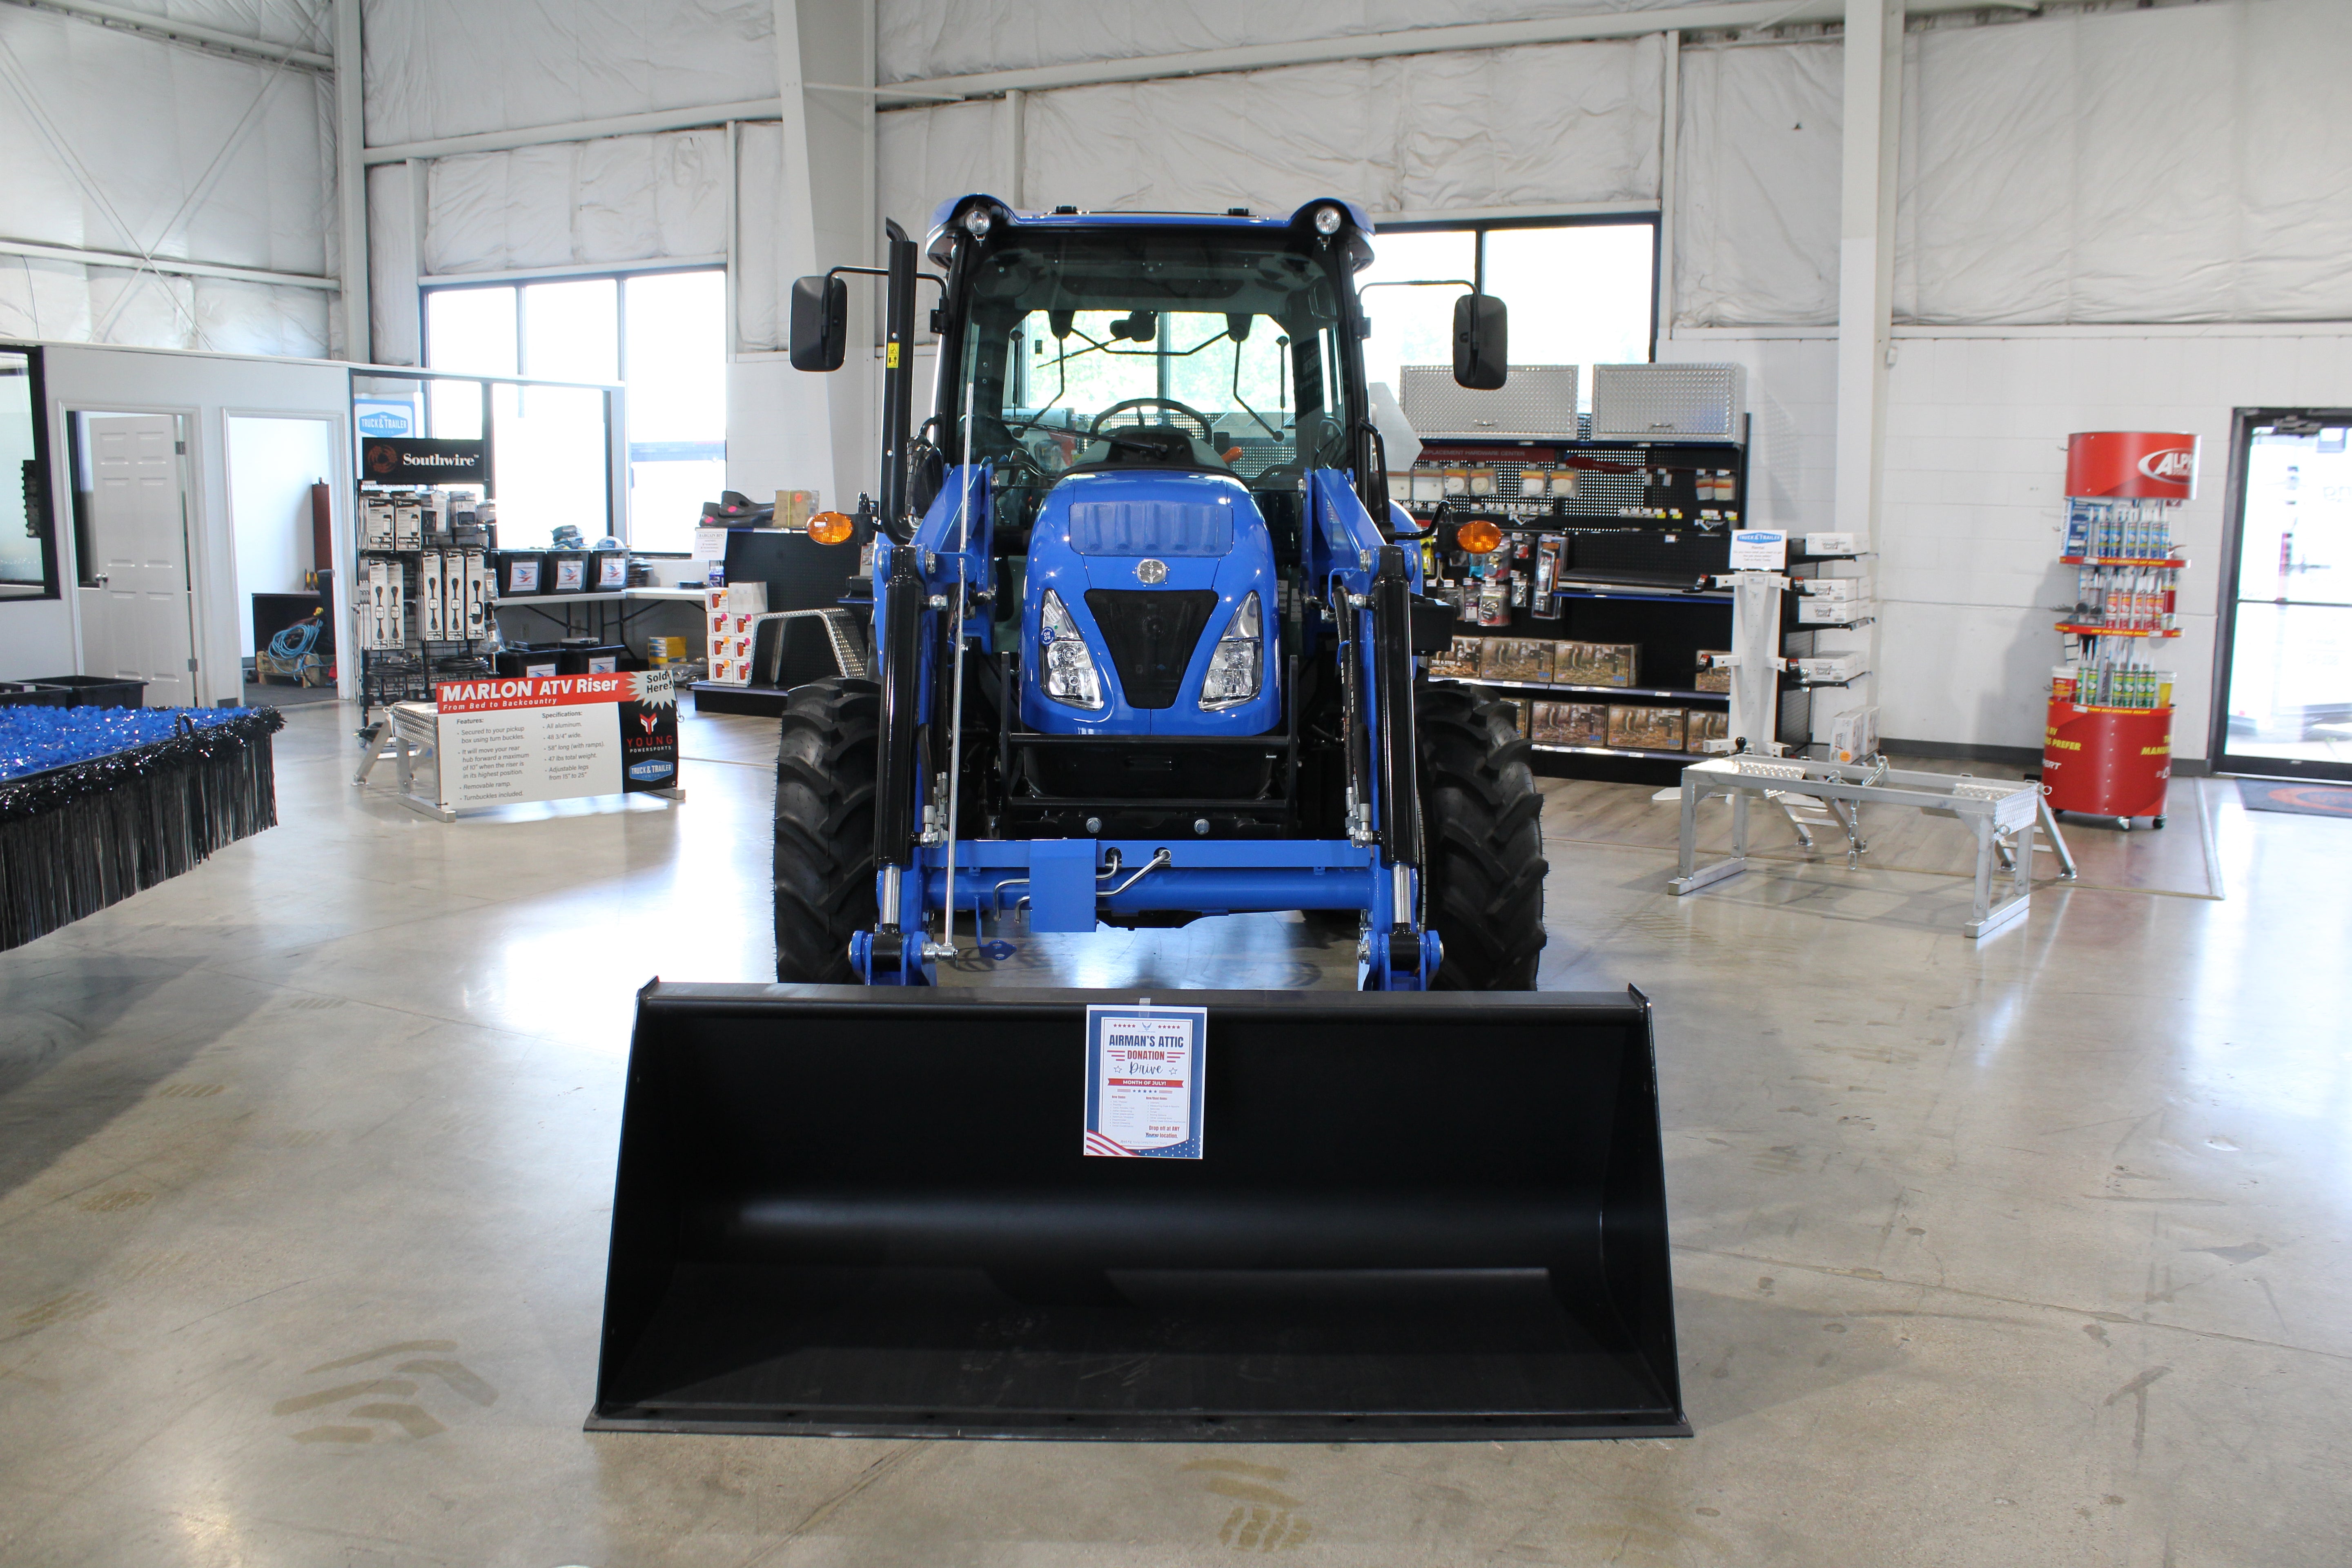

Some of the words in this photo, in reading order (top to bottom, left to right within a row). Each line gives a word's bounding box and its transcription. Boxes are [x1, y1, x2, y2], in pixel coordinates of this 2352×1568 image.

[361, 419, 379, 428] TRUCK
[379, 419, 384, 428] &
[384, 419, 407, 429] TRAILER
[403, 453, 474, 467] Southwire
[647, 671, 667, 683] Sold
[443, 681, 532, 702] MARLON
[539, 679, 572, 695] ATV
[577, 678, 618, 693] Riser
[647, 681, 672, 693] Here!
[502, 698, 557, 707] Backcountry
[542, 711, 583, 719] Specifications:
[627, 735, 673, 747] YOUNG
[2052, 739, 2081, 751] PREFER
[651, 764, 671, 773] TRAILER
[1109, 1035, 1155, 1047] AIRMAN'S
[1158, 1036, 1184, 1048] ATTIC
[1127, 1050, 1165, 1060] DONATION
[1129, 1061, 1163, 1075] Drive
